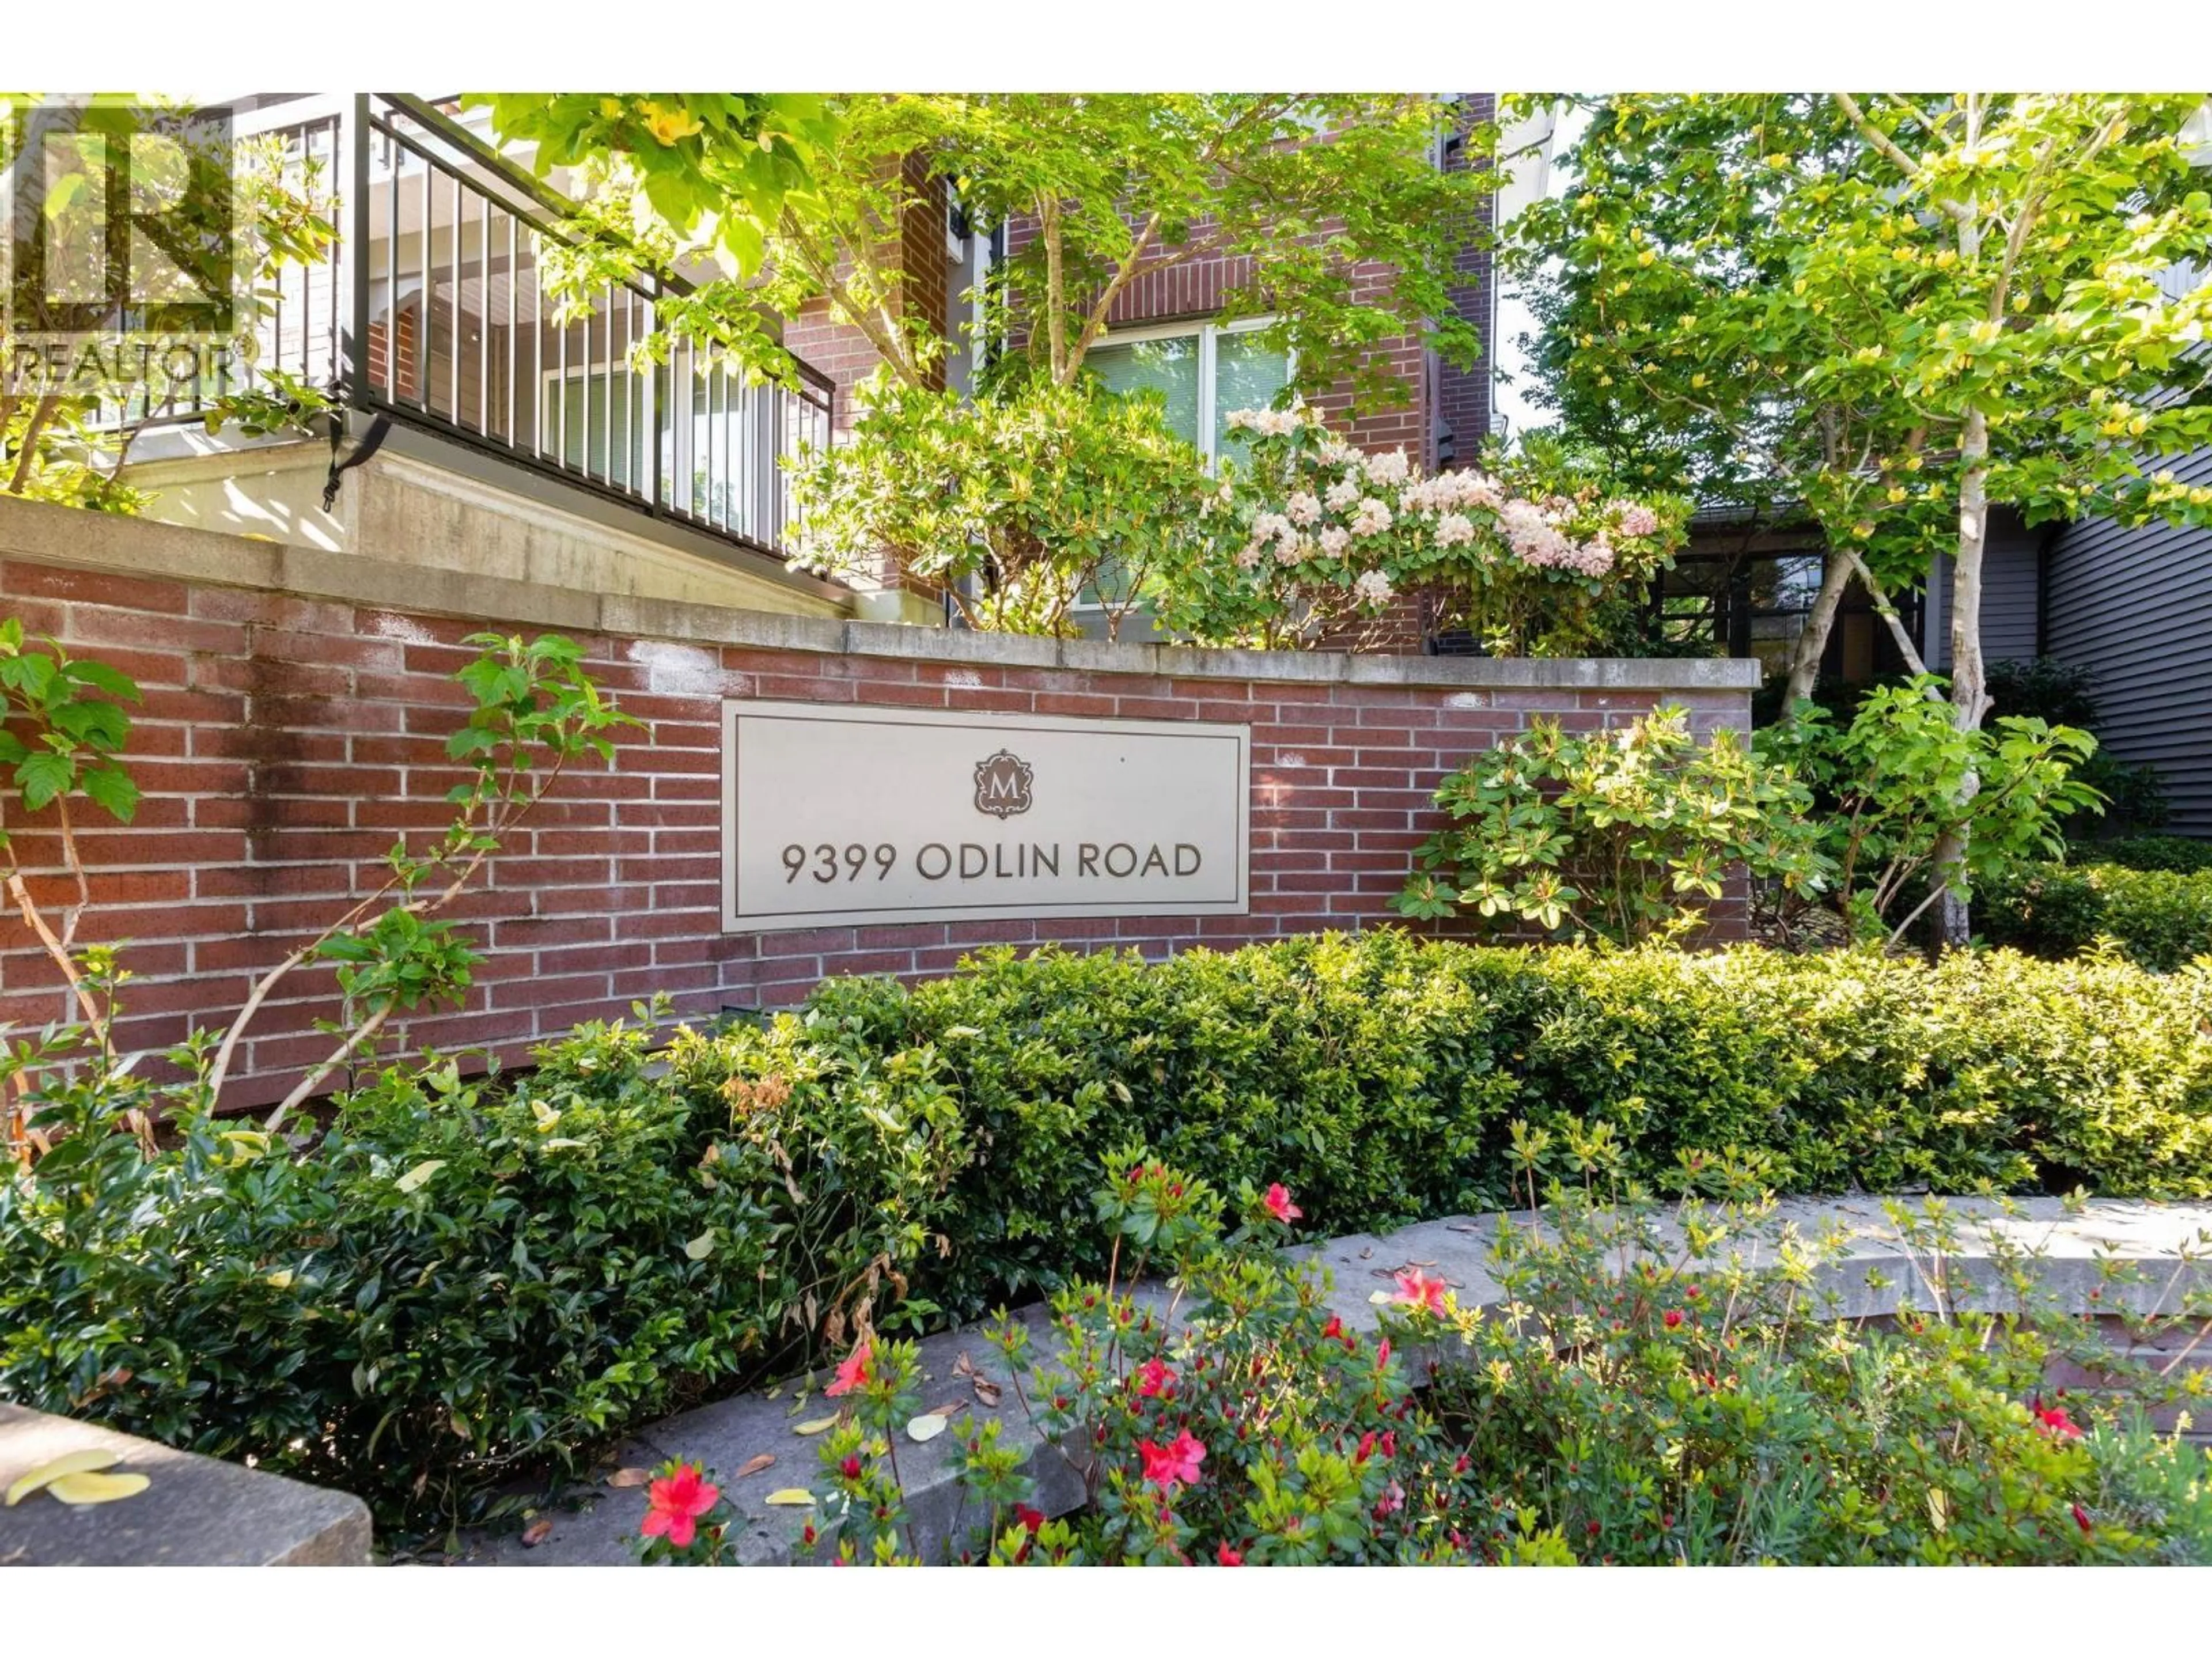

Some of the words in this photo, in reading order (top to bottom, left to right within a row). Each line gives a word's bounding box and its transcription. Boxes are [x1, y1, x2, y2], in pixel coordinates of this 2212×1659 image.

[988, 771, 1021, 799] M
[781, 843, 897, 885] 9399
[915, 843, 1059, 881] ODLIN
[1078, 842, 1202, 878] ROAD
